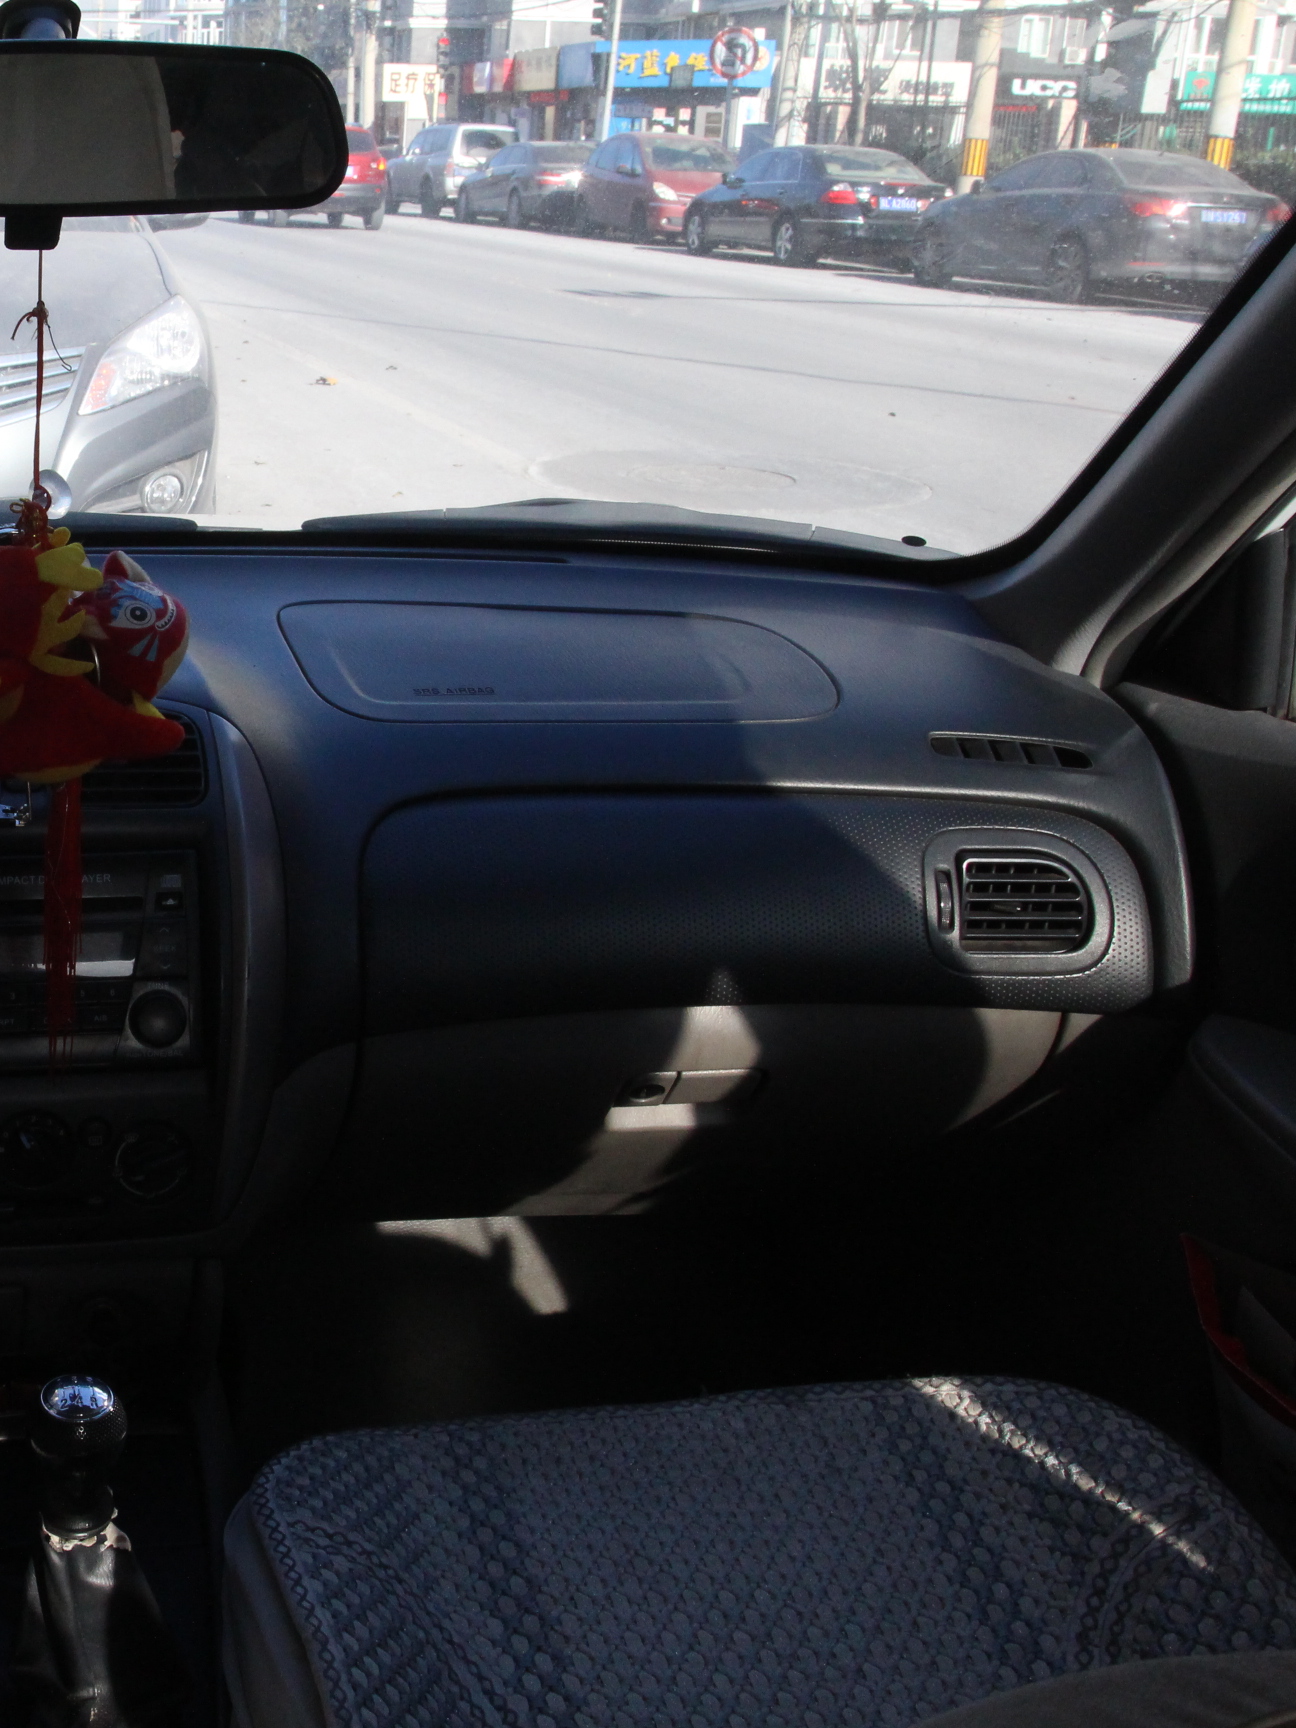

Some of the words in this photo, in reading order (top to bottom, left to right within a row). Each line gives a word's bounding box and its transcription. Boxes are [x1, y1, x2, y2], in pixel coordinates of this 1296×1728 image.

[1011, 78, 1077, 98] UCC
[412, 688, 440, 696] SRS
[445, 686, 495, 695] AIRBAG
